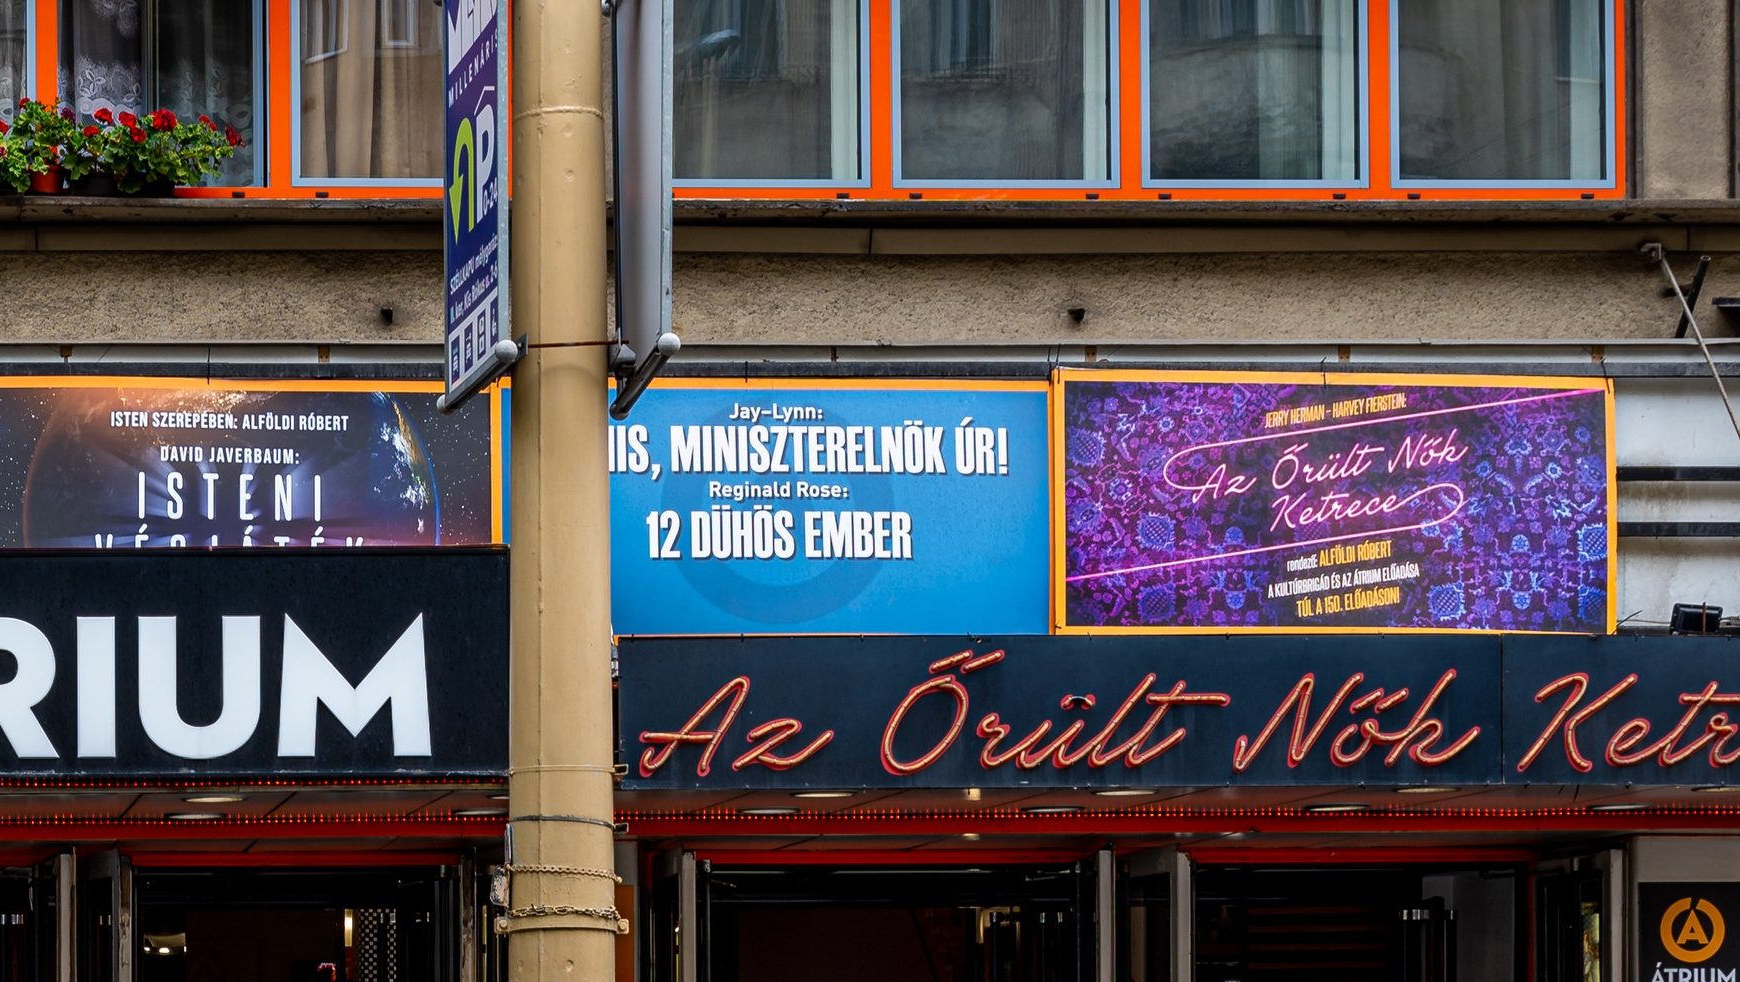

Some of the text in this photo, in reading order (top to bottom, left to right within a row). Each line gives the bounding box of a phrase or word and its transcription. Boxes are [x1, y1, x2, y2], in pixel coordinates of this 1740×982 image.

[110, 410, 349, 432] ISTEN SZEREPÉBEN: ALFÖLDI RÓBERT
[1264, 404, 1289, 429] JERRY
[1290, 402, 1325, 424] HERMAN
[1332, 398, 1365, 419] HARVEY
[209, 446, 301, 466] JAVERBAUM:
[670, 416, 1009, 475] MINISZTERELNÖK ÚR!
[1272, 443, 1385, 490] Őrült
[1388, 428, 1469, 474] Nők
[138, 470, 322, 522] ISTENI
[709, 481, 849, 500] Reginald Rose:
[1270, 491, 1408, 532] Ketrece
[646, 504, 913, 559] 12 DÜHÖS EMBER
[1319, 541, 1356, 568] ALFÖLDI
[1357, 539, 1392, 560] RÓBERT
[1275, 562, 1420, 597] KULTÚRBRIGÁD ÉS AZ ÁTRIUM ELŐADÁSA
[1296, 586, 1400, 618] TÚL 150. ELŐADÁSON!
[639, 649, 1740, 778] Az Őrült Nők Ketr
